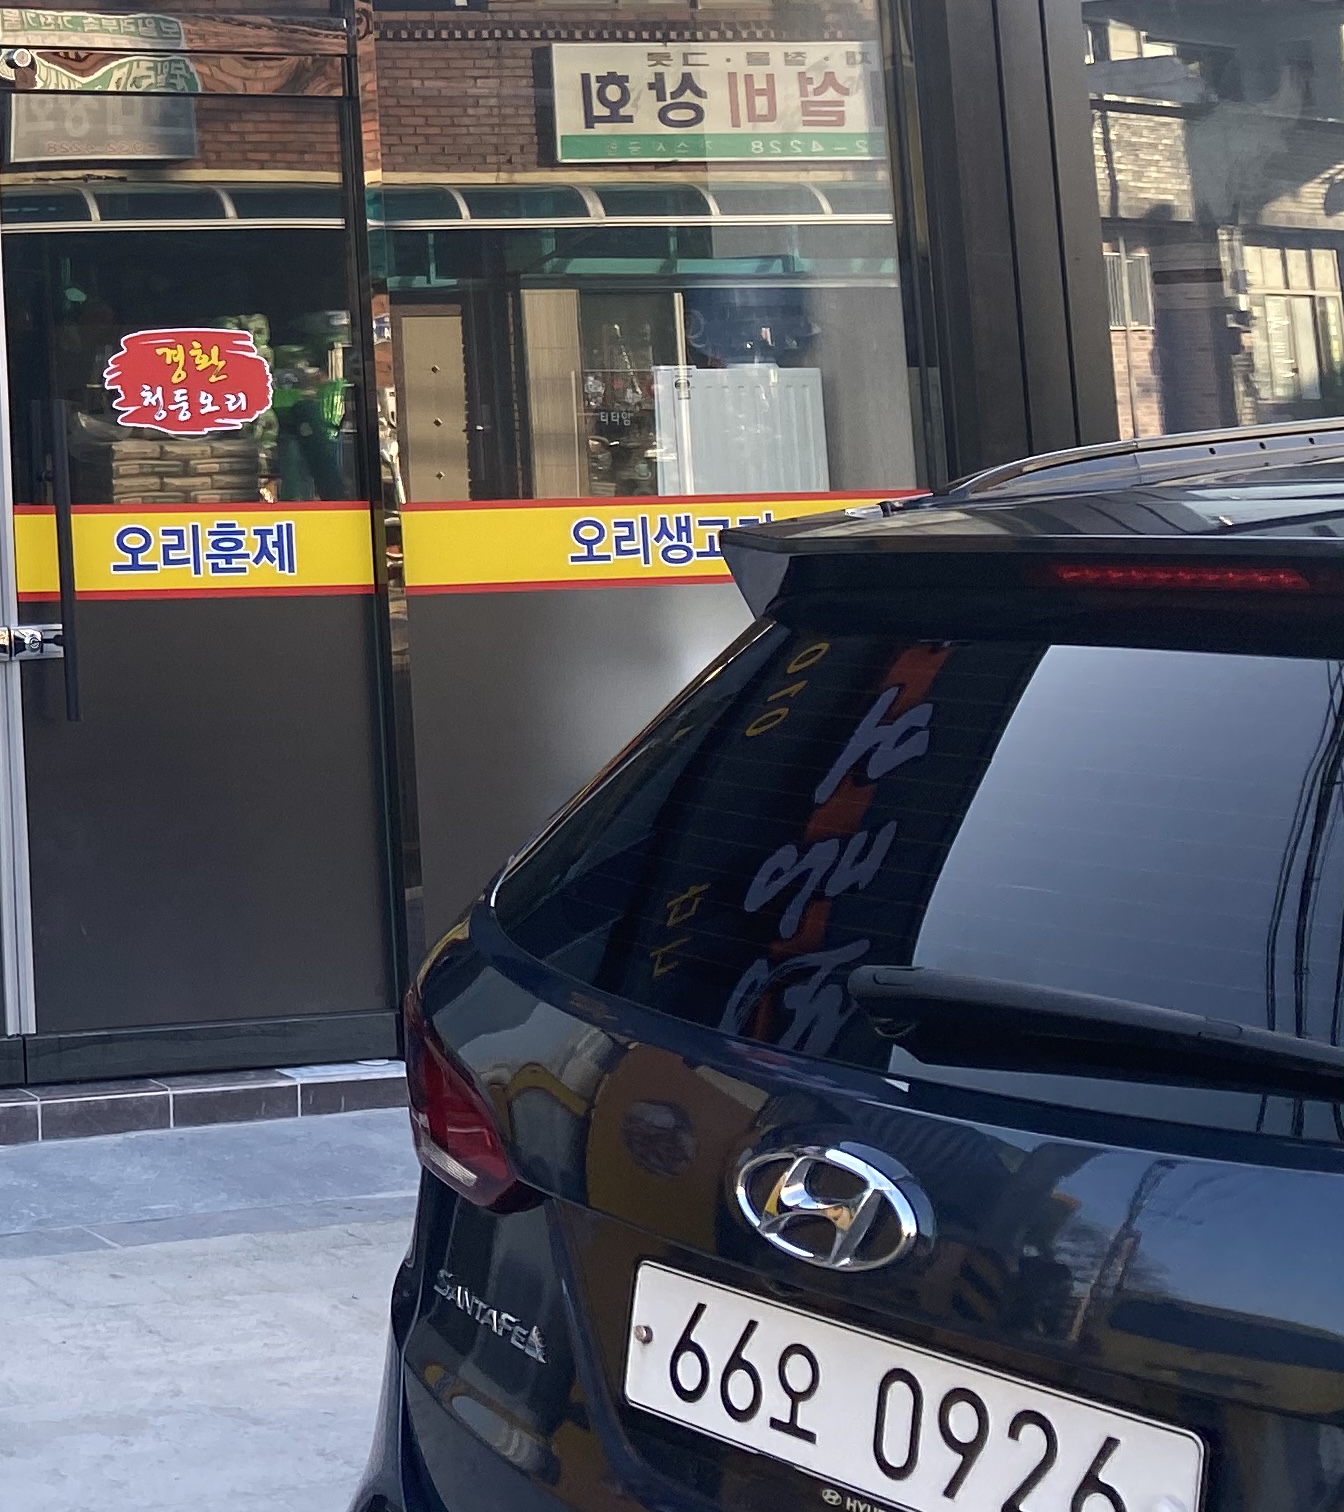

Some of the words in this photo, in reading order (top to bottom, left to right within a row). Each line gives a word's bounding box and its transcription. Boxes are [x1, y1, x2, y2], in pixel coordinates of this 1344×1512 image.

[111, 521, 297, 578] 오리훈제
[668, 1303, 820, 1445] 66오
[873, 1367, 1127, 1512] 0926
